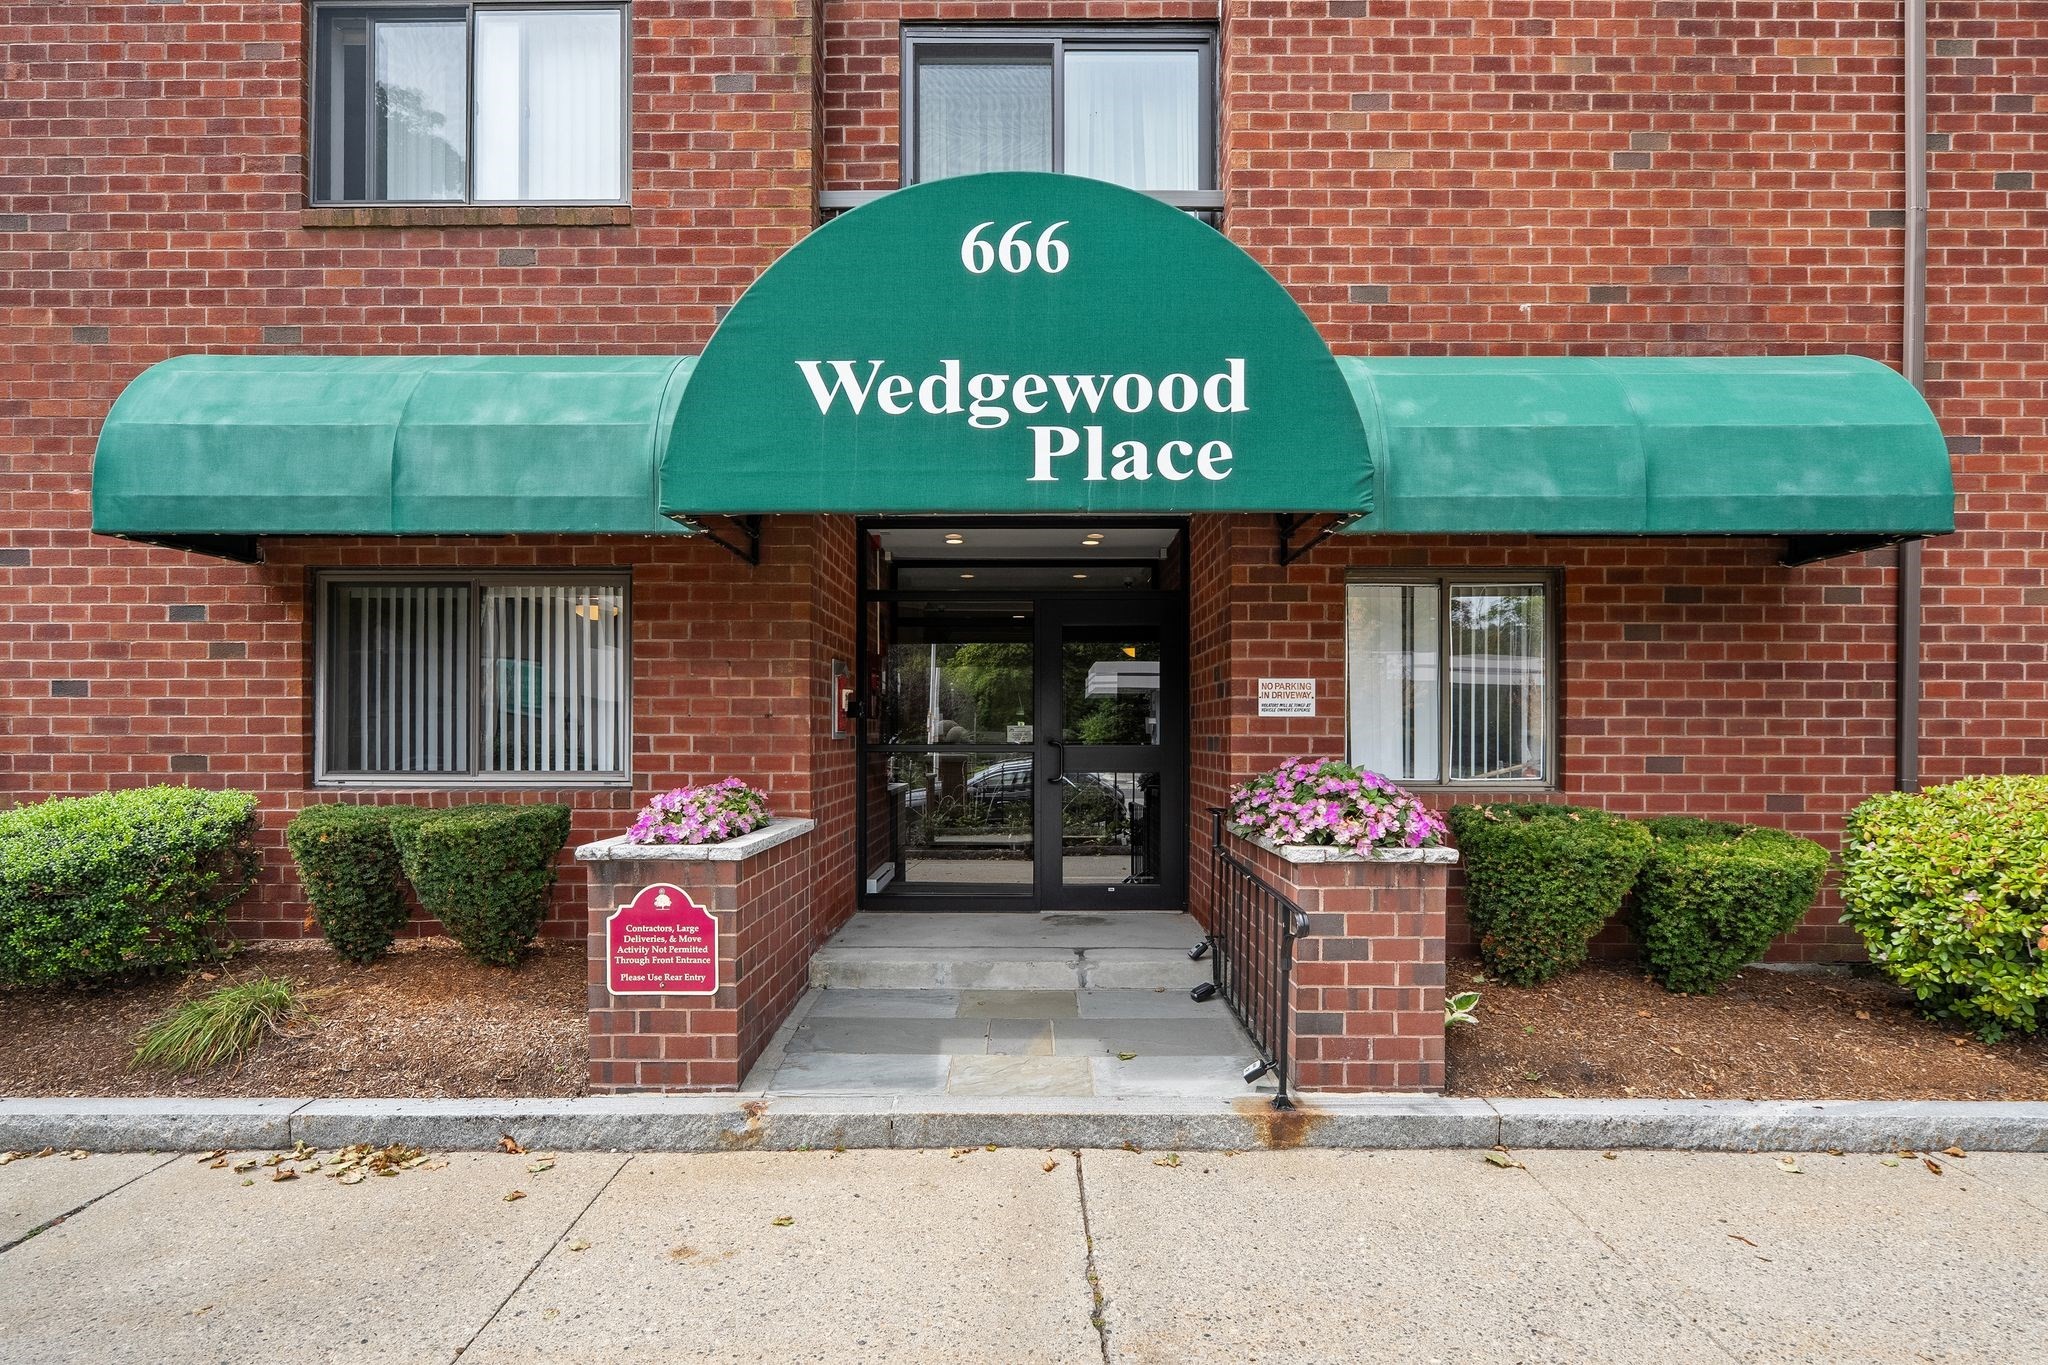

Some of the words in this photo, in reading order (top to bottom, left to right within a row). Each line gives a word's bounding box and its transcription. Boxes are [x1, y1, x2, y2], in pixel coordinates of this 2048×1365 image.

[962, 221, 1070, 274] 666
[795, 358, 1250, 429] Wedgewood
[1026, 425, 1233, 481] Place
[1261, 682, 1273, 690] NO
[1274, 682, 1312, 690] PARKING
[1261, 691, 1270, 699] IN
[1271, 691, 1312, 699] DRIVEWAY
[625, 924, 675, 934] Contractors,
[676, 924, 700, 934] Large
[623, 934, 668, 944] Deliveries,
[669, 935, 677, 943] &
[678, 934, 702, 943] Move
[617, 945, 650, 956] Activity
[651, 945, 668, 954] Not
[668, 945, 709, 954] Permitted
[614, 956, 651, 967] Through
[651, 956, 675, 964] Front
[675, 956, 711, 964] Entrance
[620, 973, 646, 982] Please
[647, 973, 663, 982] Use
[664, 973, 683, 982] Rear
[684, 973, 707, 983] Entry
